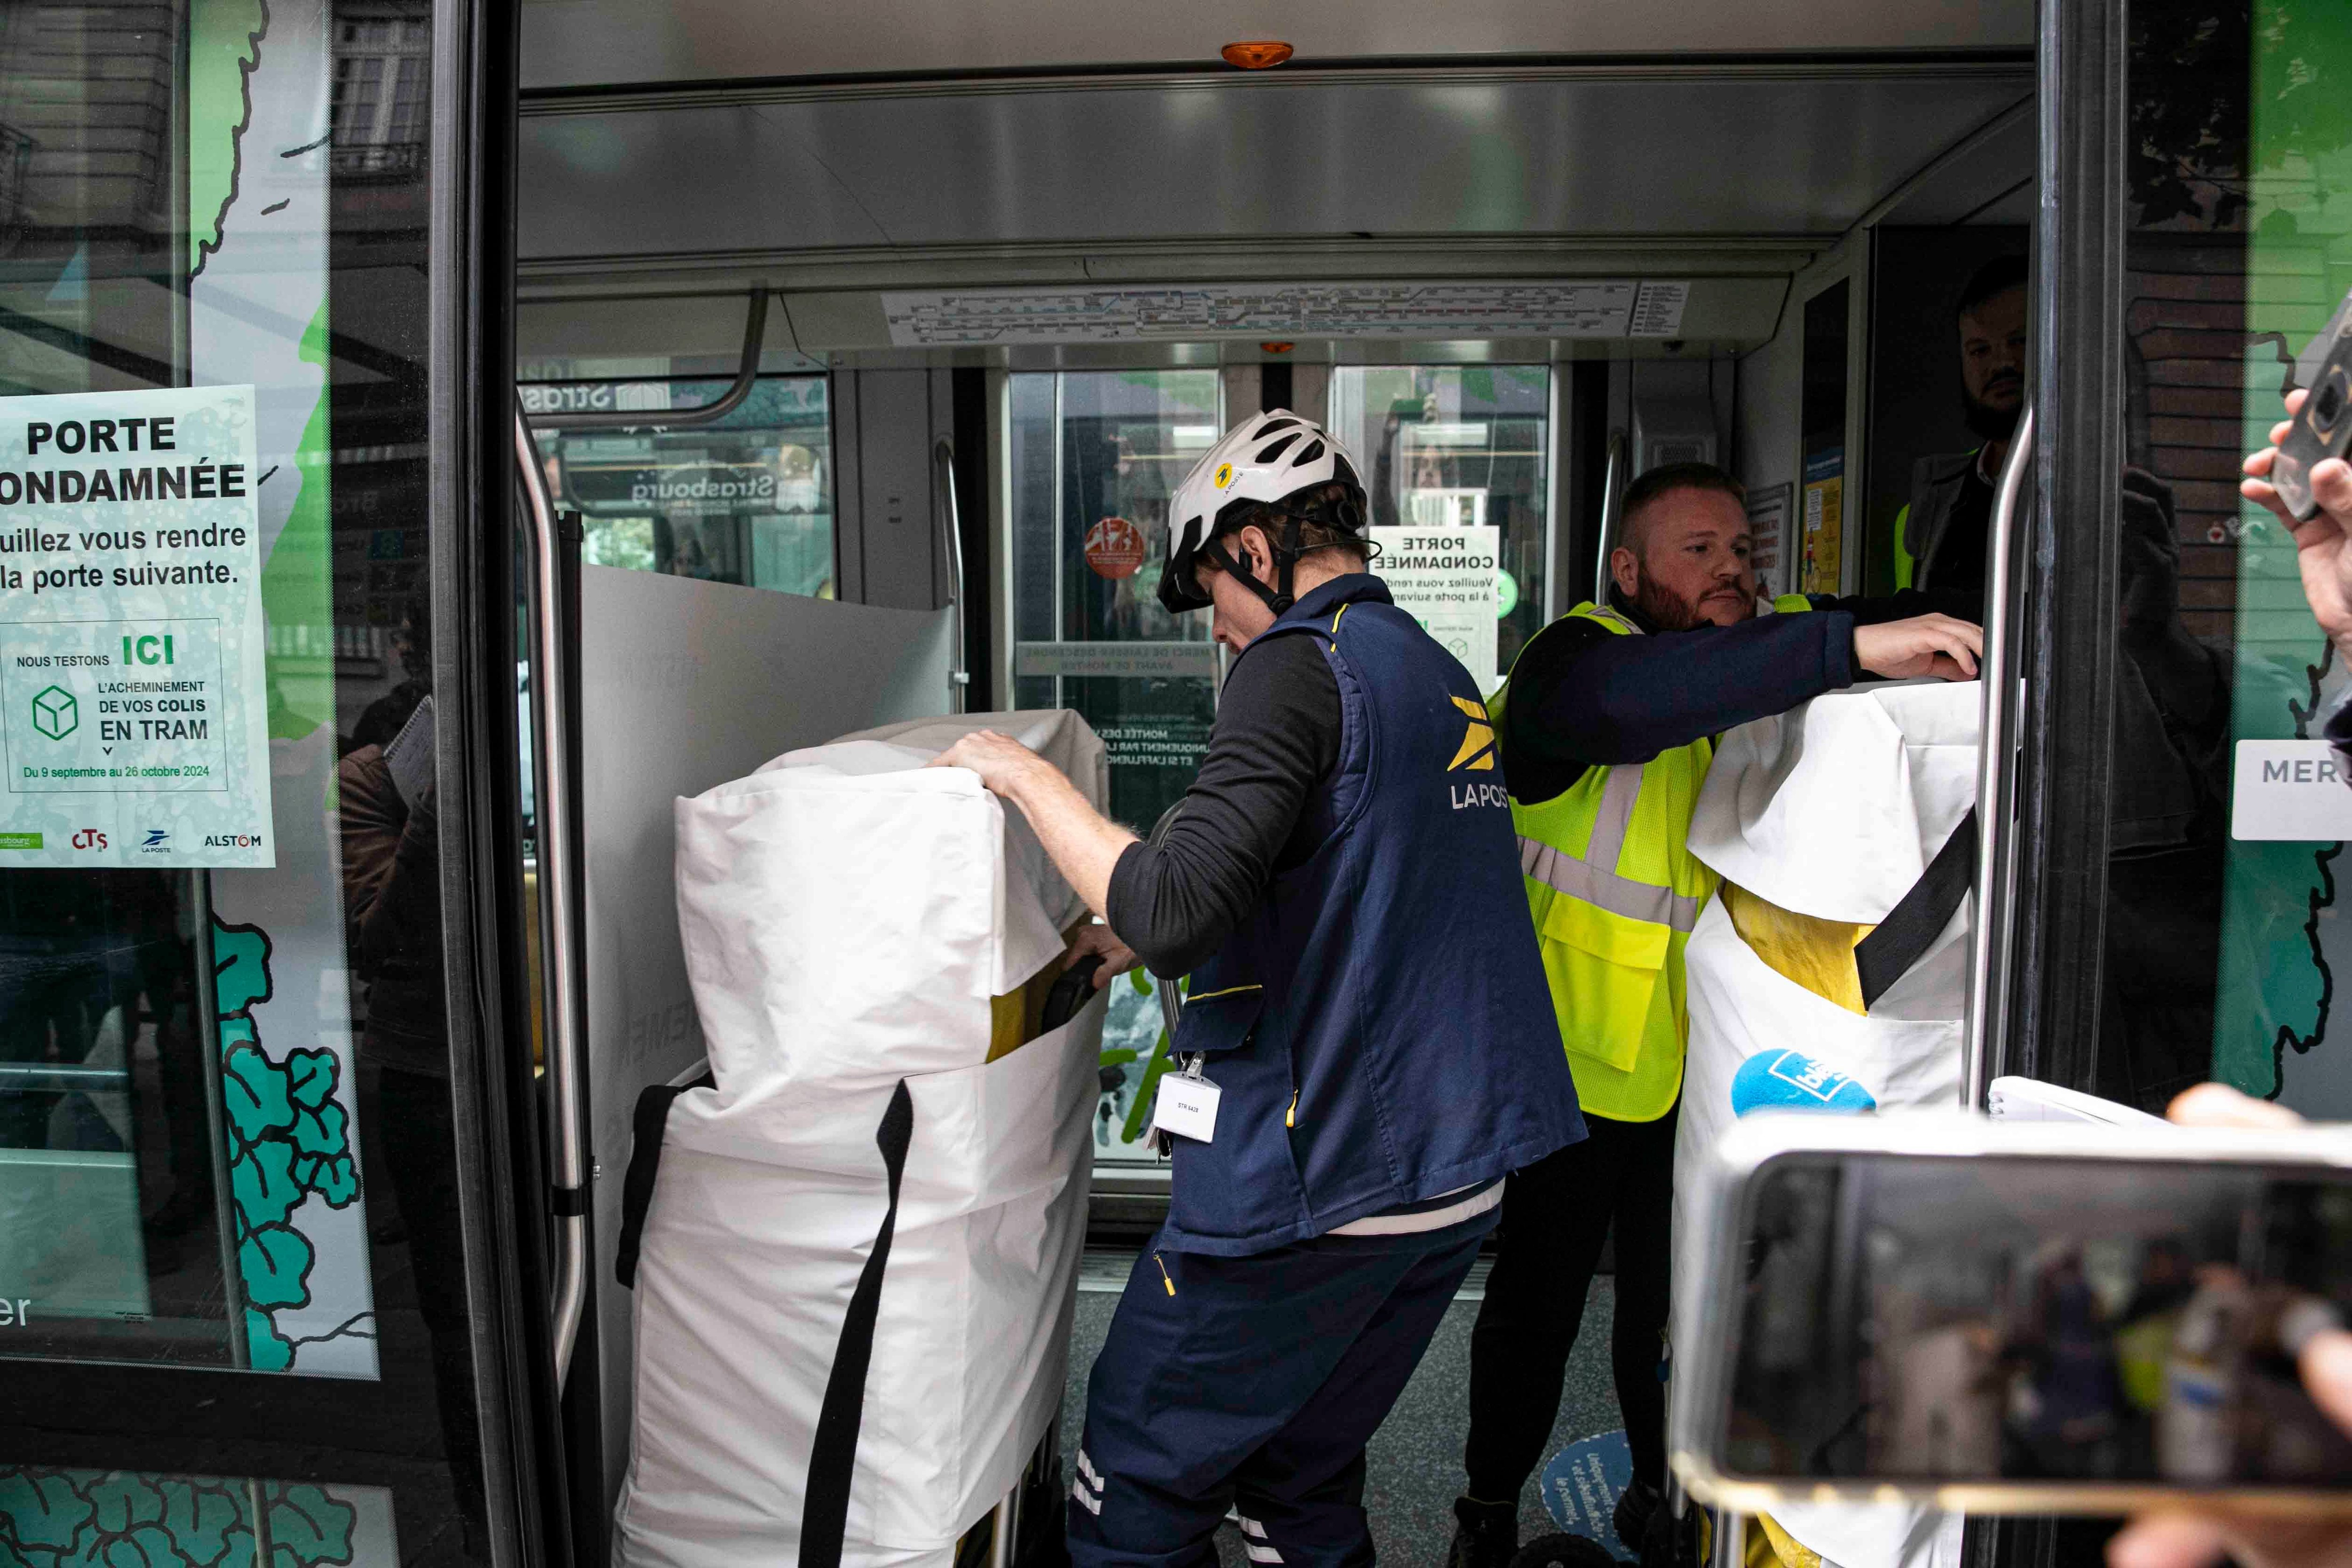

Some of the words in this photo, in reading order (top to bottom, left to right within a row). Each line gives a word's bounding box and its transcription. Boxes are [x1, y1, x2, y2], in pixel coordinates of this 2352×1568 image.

[27, 417, 175, 454] PORTE
[0, 457, 246, 505] ONDAMNÉE
[0, 528, 71, 552] uillez
[79, 530, 146, 550] vous
[157, 522, 246, 549] rendre
[1, 566, 22, 589] la
[33, 564, 103, 594] porte
[113, 561, 238, 587] suivante.
[17, 657, 51, 668] NOUS
[54, 655, 110, 667] TESTONS
[123, 635, 175, 666] ICI
[98, 681, 205, 693] L'ACHEMINEMENT
[99, 701, 119, 713] DE
[122, 700, 153, 713] VOS
[158, 699, 206, 712] COLIS
[101, 720, 131, 740] EN
[139, 719, 207, 740] TRAM
[24, 767, 39, 778] Du
[41, 767, 48, 778] 9
[51, 766, 106, 780] septembre
[110, 769, 122, 778] au
[125, 766, 138, 777] 26
[142, 766, 180, 777] octobre
[183, 765, 209, 777] 2024
[2263, 760, 2337, 783] MER
[72, 828, 108, 849] CTS
[205, 834, 261, 847] ALSTOM
[0, 1298, 31, 1326] er
